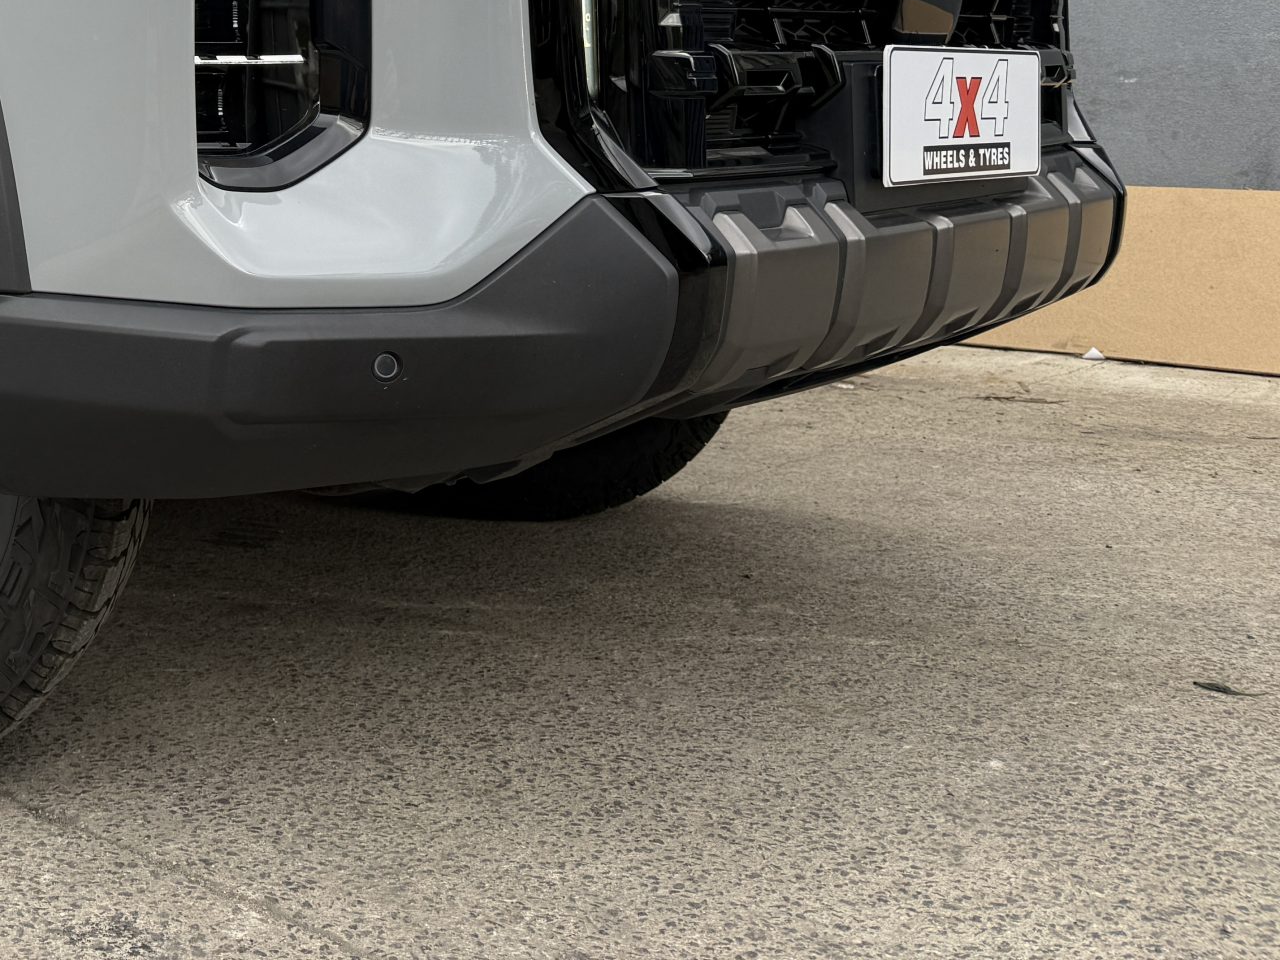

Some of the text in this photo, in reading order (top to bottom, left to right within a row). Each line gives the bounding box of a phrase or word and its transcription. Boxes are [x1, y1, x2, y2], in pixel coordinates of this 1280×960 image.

[924, 146, 1009, 170] WHEELS & TYRES
